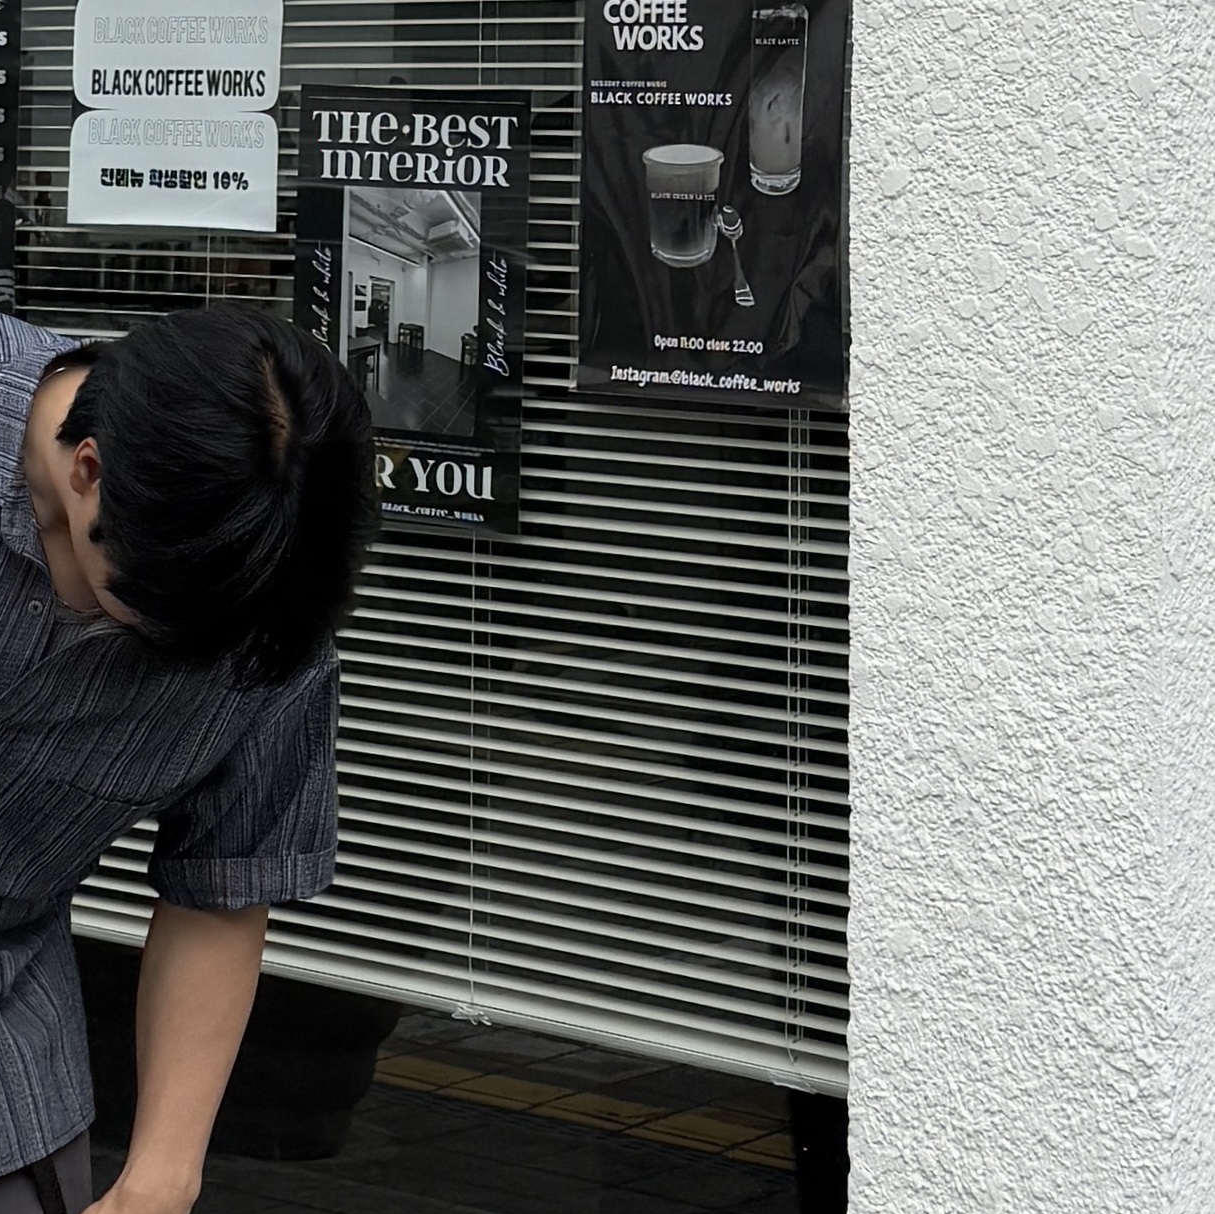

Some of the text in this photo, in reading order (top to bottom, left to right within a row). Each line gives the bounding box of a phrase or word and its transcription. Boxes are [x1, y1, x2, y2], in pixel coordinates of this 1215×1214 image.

[603, 0, 687, 24] COFFEE
[94, 16, 269, 44] BLACK COFFEE WORKS
[612, 25, 705, 51] WORKS
[91, 69, 266, 97] BLACK COFFEE WORKS
[590, 91, 733, 106] BLACK COFFEE WORKS
[88, 118, 265, 149] BLACK COFFEE WORKS
[213, 171, 249, 190] 10%
[654, 335, 678, 350] Open
[706, 339, 730, 351] close
[732, 340, 764, 354] 22:00
